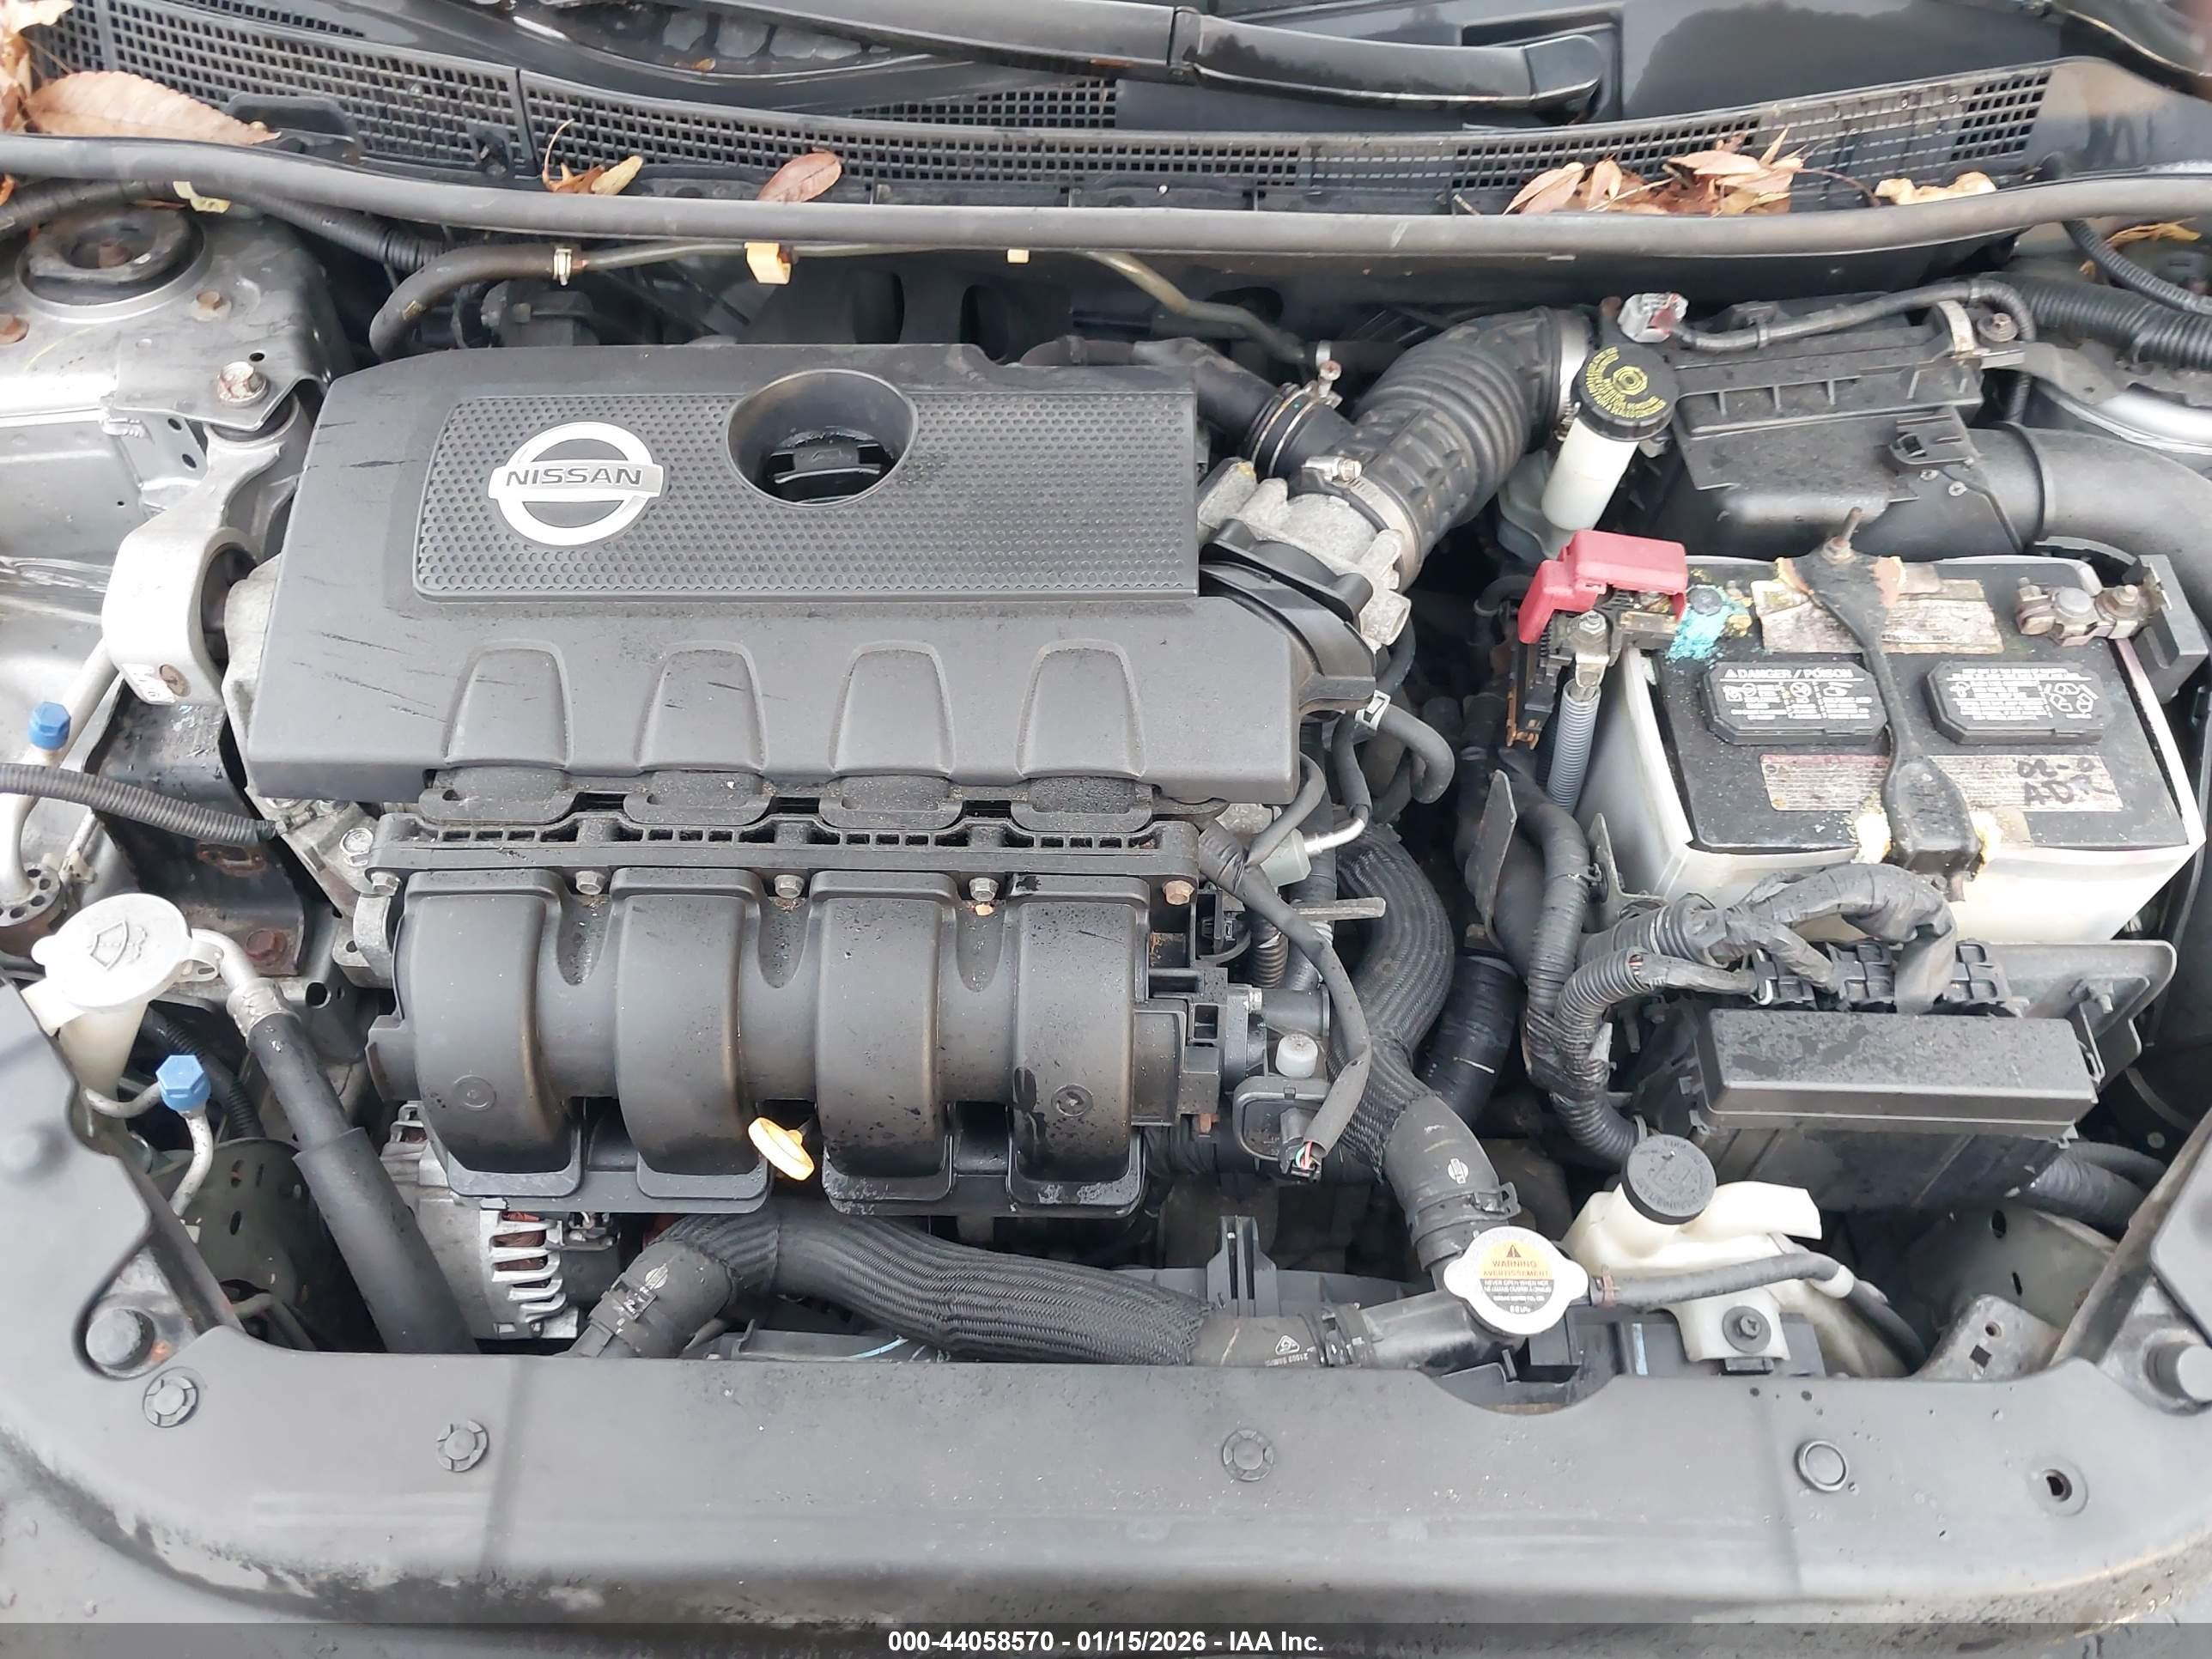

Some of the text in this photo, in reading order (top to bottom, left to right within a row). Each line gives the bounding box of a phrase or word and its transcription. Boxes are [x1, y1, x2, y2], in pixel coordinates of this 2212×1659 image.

[505, 467, 642, 487] NISSAN
[1737, 669, 1792, 678] DANGER
[1492, 1260, 1538, 1268] WARNING
